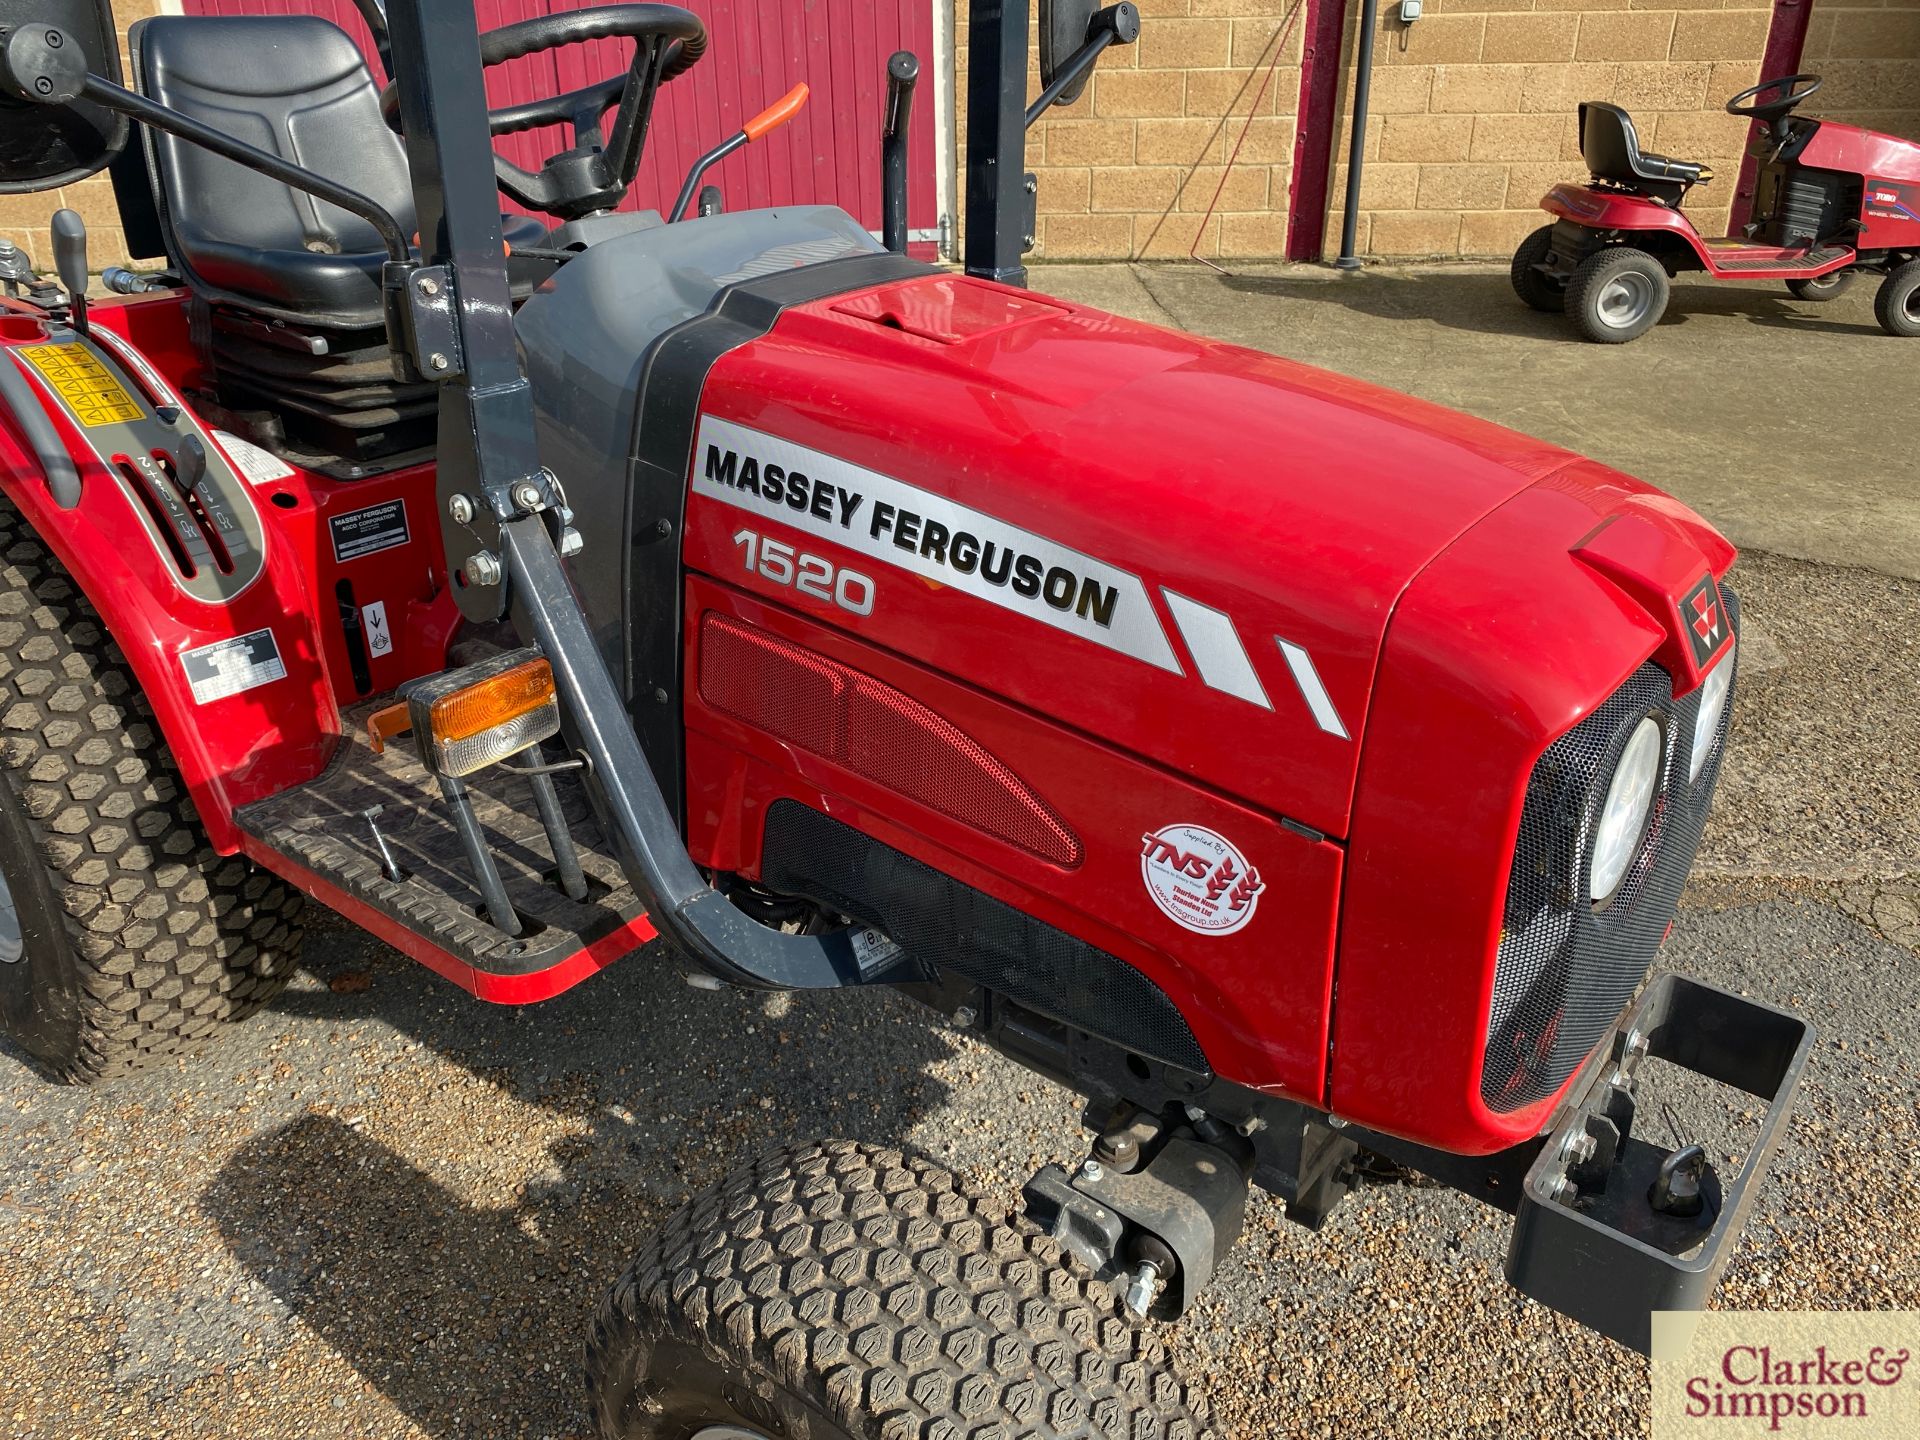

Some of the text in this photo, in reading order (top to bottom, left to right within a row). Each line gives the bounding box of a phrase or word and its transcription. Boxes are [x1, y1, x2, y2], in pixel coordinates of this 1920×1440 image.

[1875, 192, 1896, 203] TORO
[334, 505, 397, 526] MASSEY FERGUSON
[341, 523, 358, 531] AGCO
[358, 513, 396, 527] CORPORATION
[705, 444, 1118, 629] MASSEY FERGUSON
[733, 527, 876, 616] 1520
[191, 638, 246, 658] MASSEY FERGUSON
[1183, 829, 1226, 855] Supplied By
[1143, 834, 1213, 879] TNS
[1154, 883, 1232, 926] www.tnsgroup.co.uk
[1172, 885, 1219, 911] Thurlow Nunn
[1172, 894, 1213, 918] Standen Ltd
